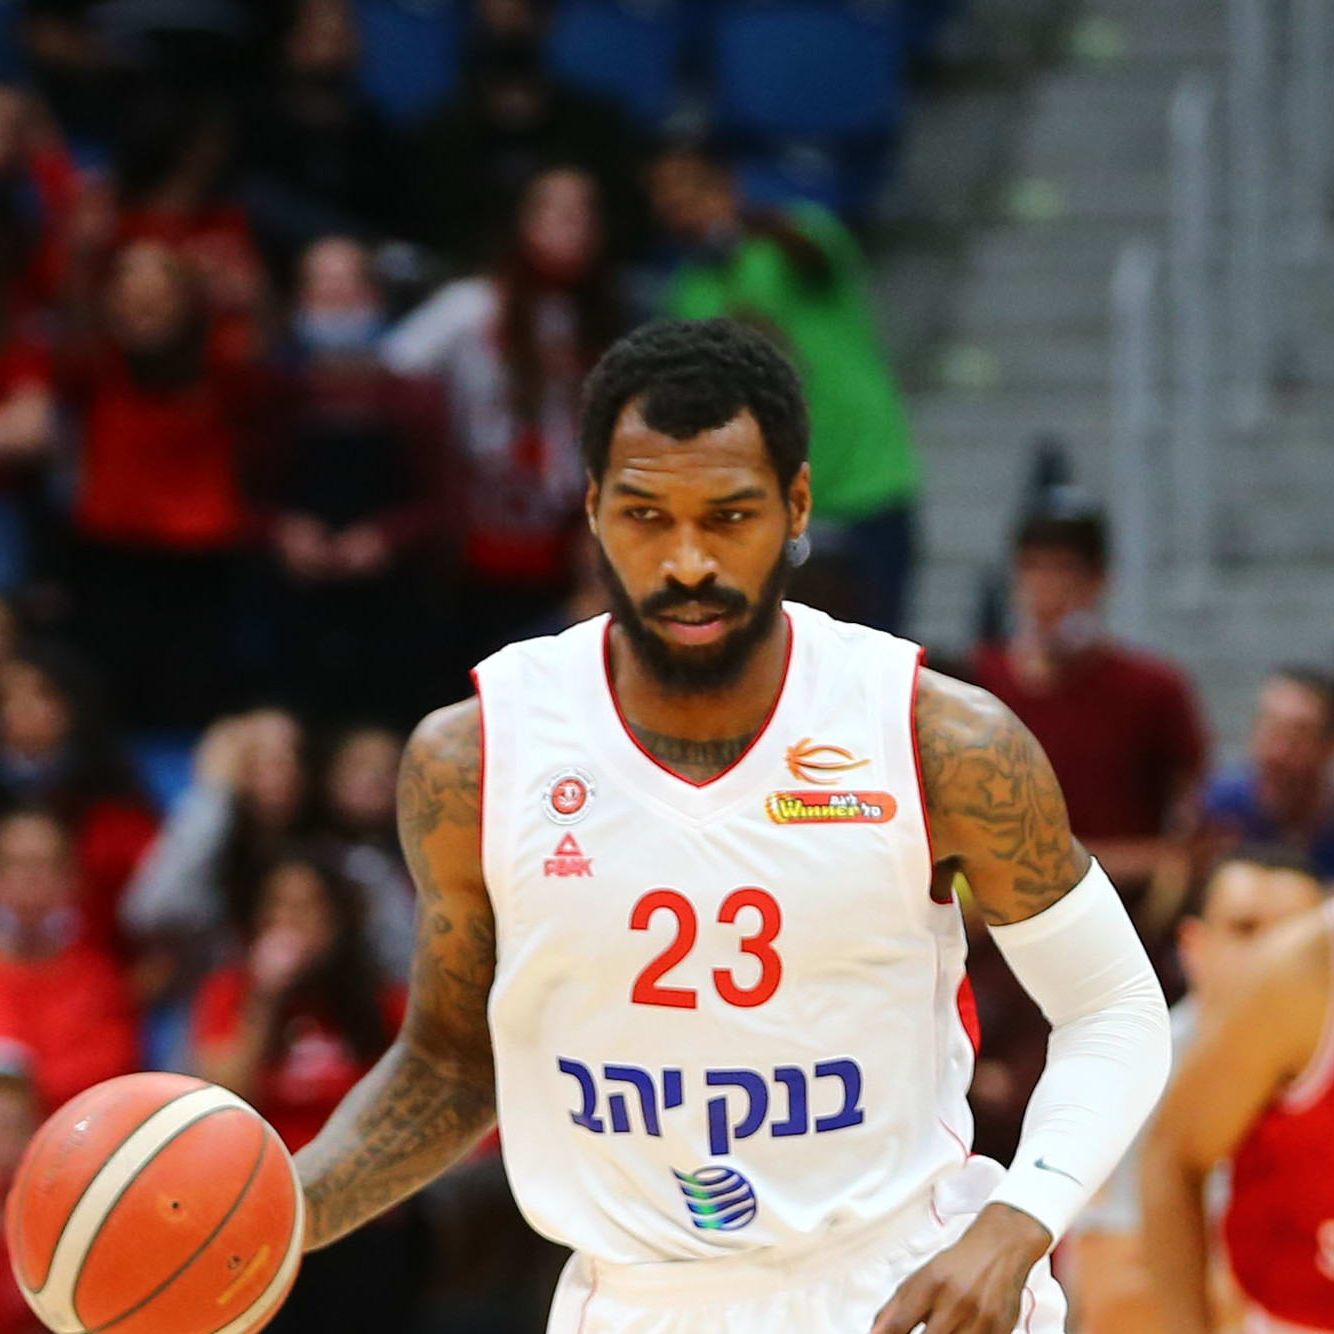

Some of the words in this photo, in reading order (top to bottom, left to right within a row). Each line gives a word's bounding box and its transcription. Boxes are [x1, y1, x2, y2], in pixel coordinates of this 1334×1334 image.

[778, 797, 861, 818] Winner
[629, 886, 784, 1010] 23
[557, 1056, 684, 1138] יהב
[705, 1056, 866, 1156] בנק
